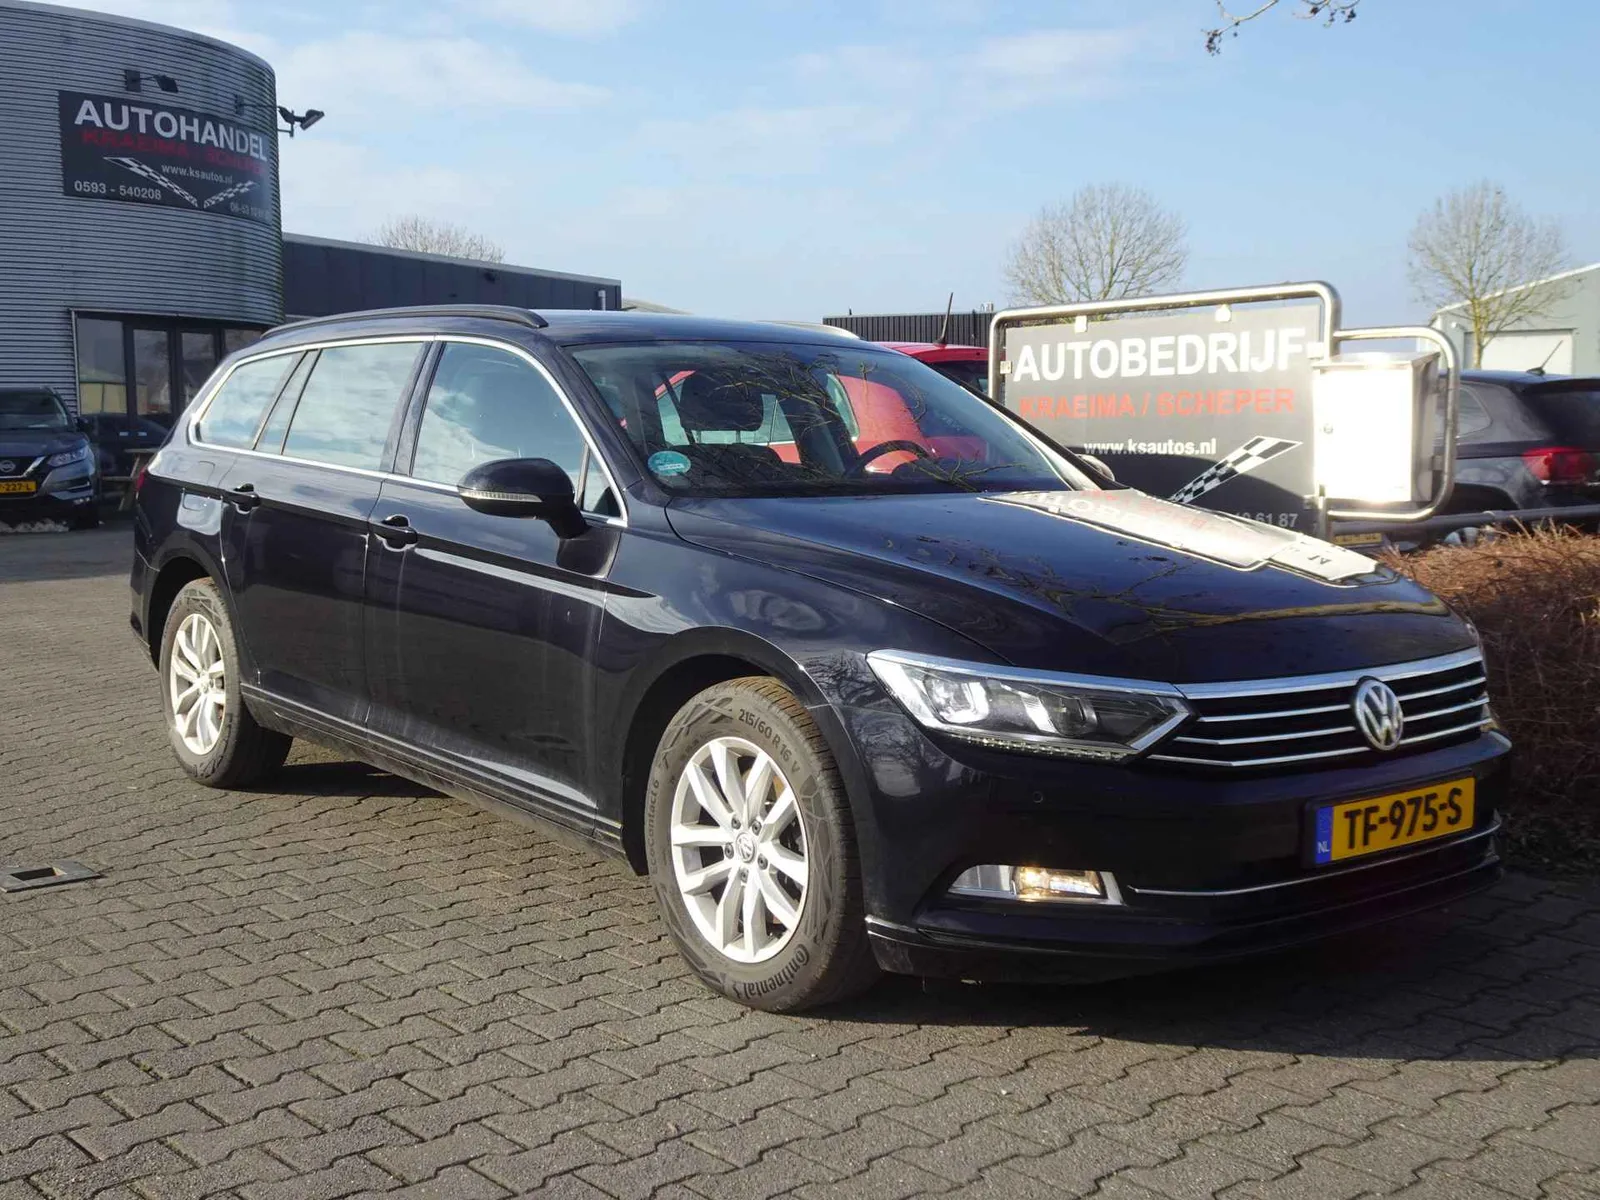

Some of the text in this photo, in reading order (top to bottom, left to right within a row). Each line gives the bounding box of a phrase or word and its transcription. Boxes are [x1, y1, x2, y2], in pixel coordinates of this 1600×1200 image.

[74, 100, 267, 161] AUTOHANDEL
[74, 180, 107, 194] 0593
[119, 185, 162, 200] 540208
[161, 164, 233, 184] www.ksautos.nl
[1014, 329, 1305, 382] AUTOBEDRIJF
[1019, 388, 1295, 420] KRAEIMA / SCHEPER
[1083, 438, 1217, 455] www.ksautos.nl
[1279, 513, 1299, 528] 87
[739, 708, 773, 739] 215/60
[772, 734, 781, 749] R
[780, 743, 793, 762] 16
[1344, 787, 1463, 849] TF-975-S
[1317, 841, 1330, 854] NL
[743, 943, 810, 999] Continental
